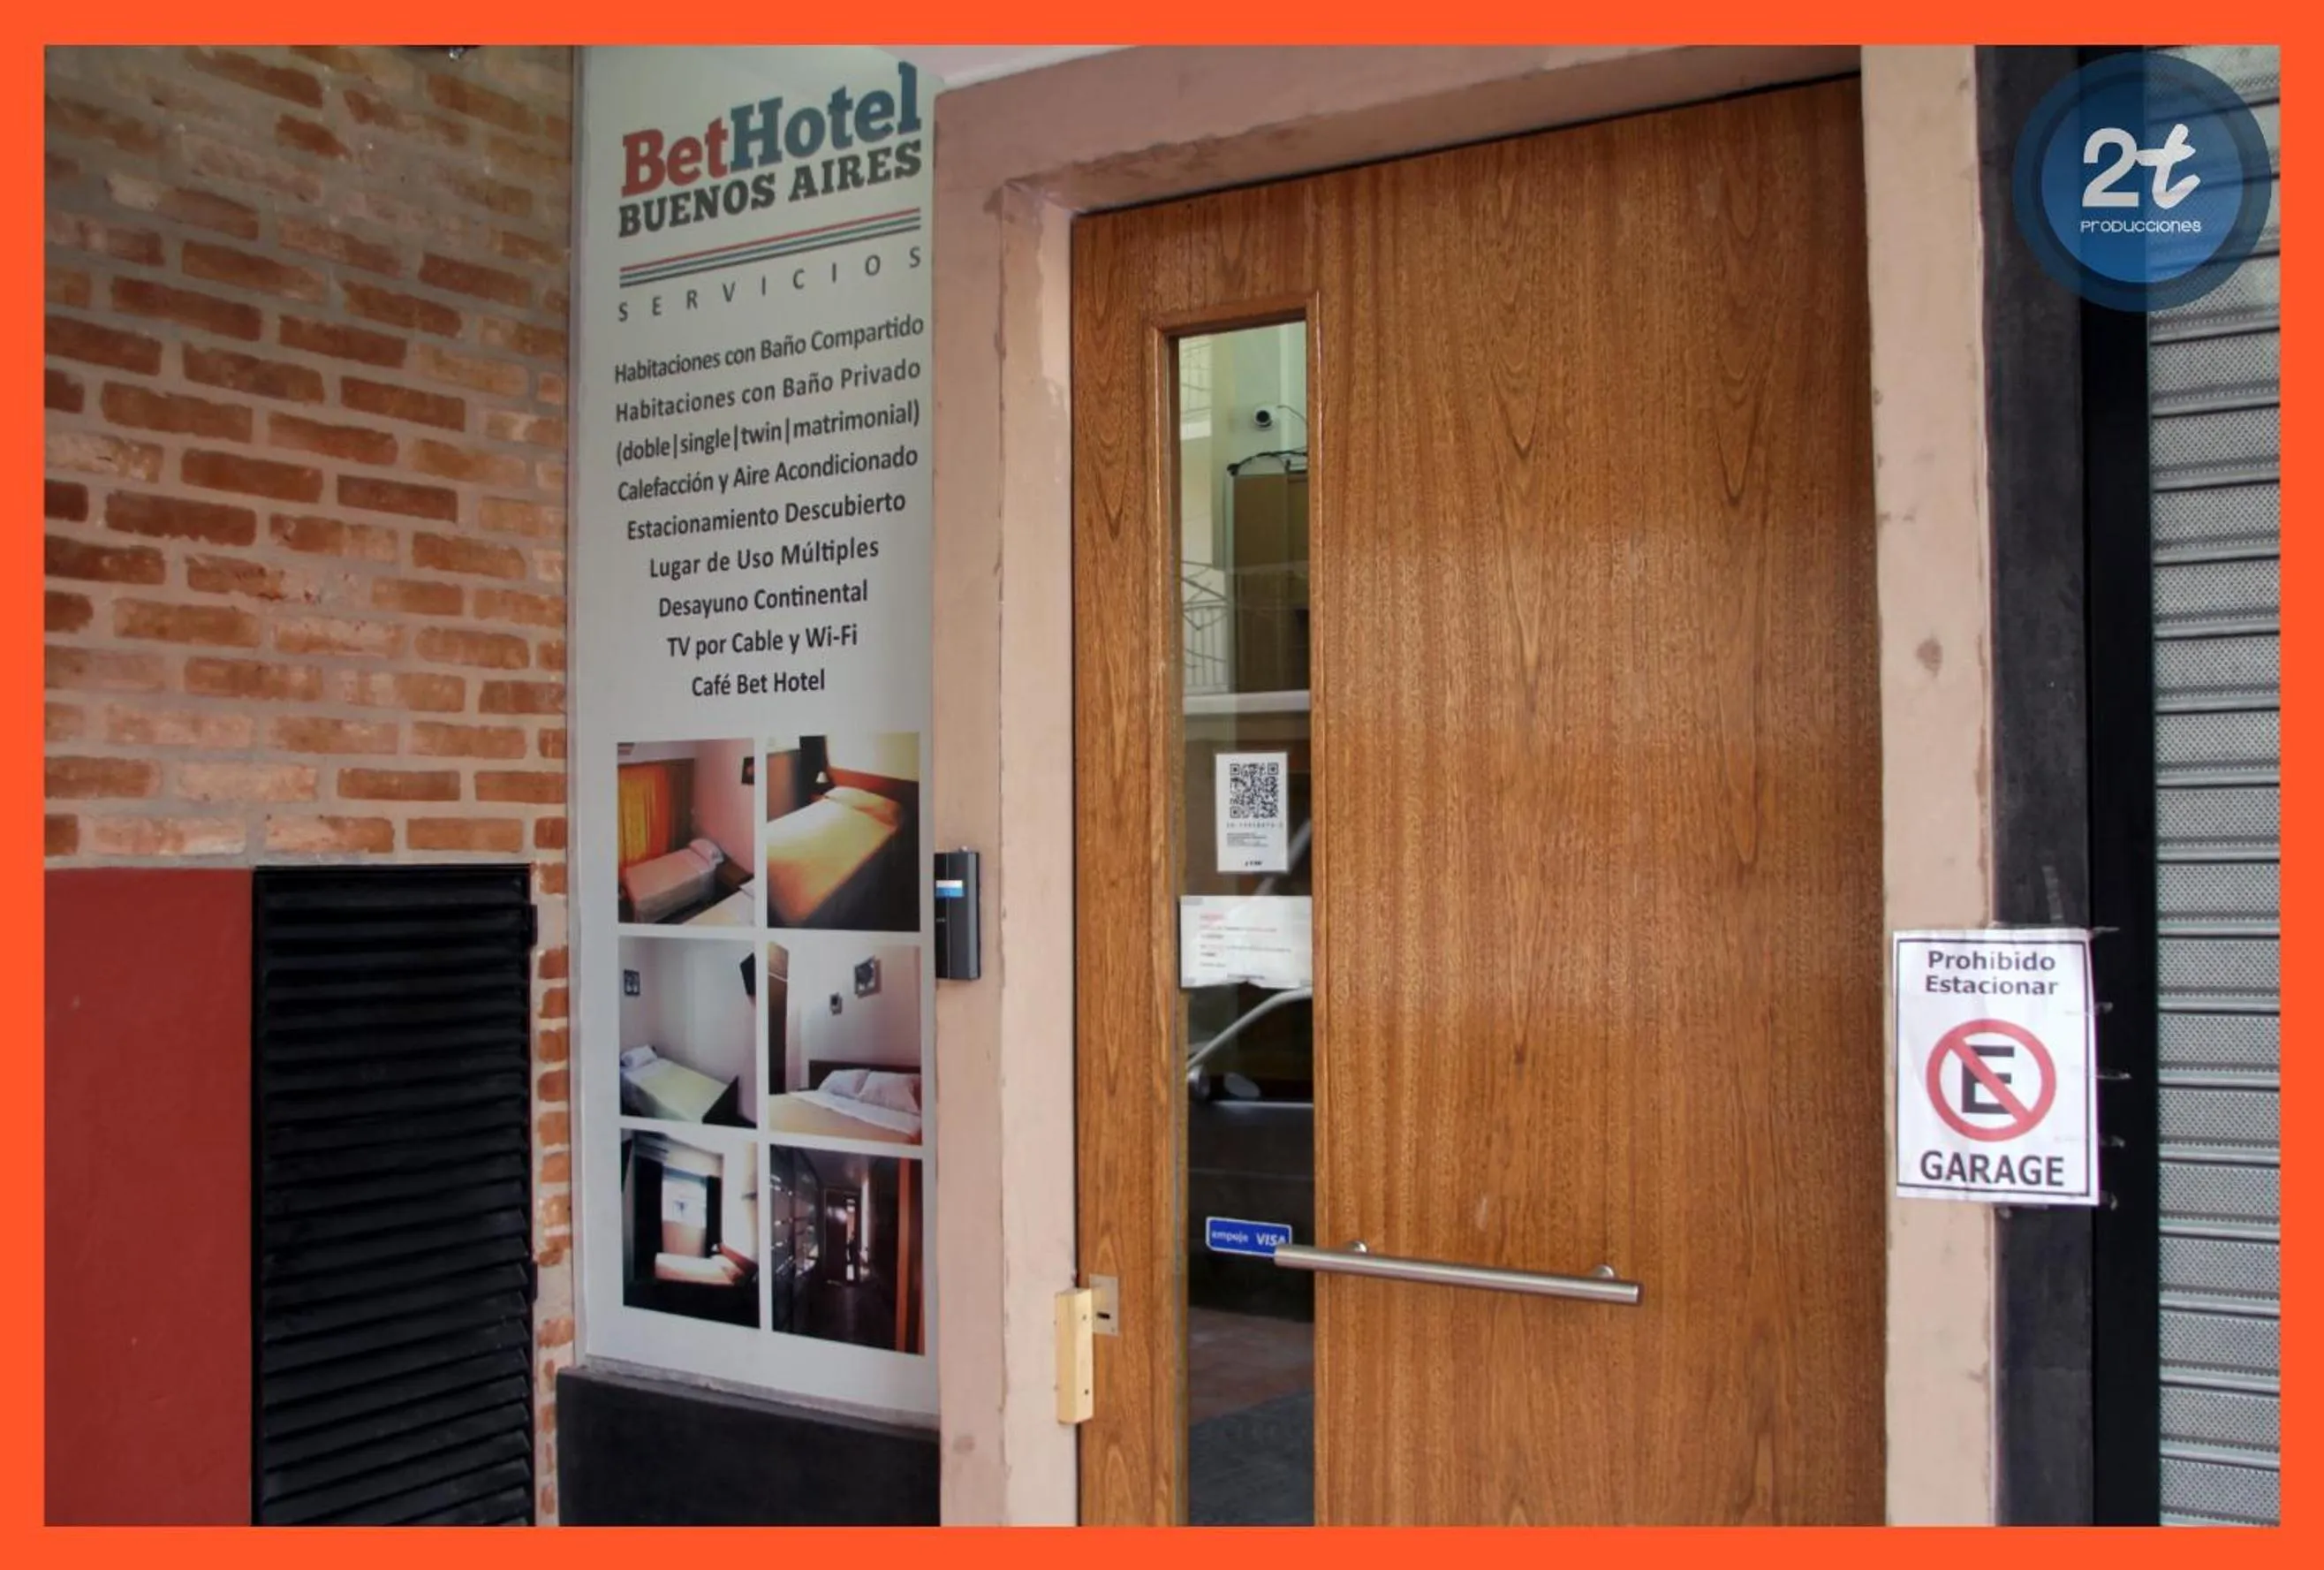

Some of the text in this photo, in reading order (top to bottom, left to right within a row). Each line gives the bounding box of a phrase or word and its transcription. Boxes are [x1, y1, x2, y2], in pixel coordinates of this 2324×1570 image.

[622, 61, 921, 196] BetHotel
[619, 140, 921, 238] BUENOS AIRES
[614, 314, 924, 384] Habitaciones con Baño Compartido
[616, 359, 920, 422] Habitaciones con Baño Privado
[617, 445, 918, 502] Calefacción y Aire Acondicionado
[627, 492, 906, 540] Estacionamiento Descubierto
[649, 536, 880, 580] Lugar de Uso Múltiples
[659, 579, 868, 618] Desayuno Continental
[667, 624, 858, 661] TV por Cable y Wi-Fi
[692, 668, 826, 696] Café Bet Hotel
[1927, 950, 2056, 971] Prohibido
[1926, 975, 2059, 996] Estacionar
[1920, 1150, 2065, 1187] GARAGE
